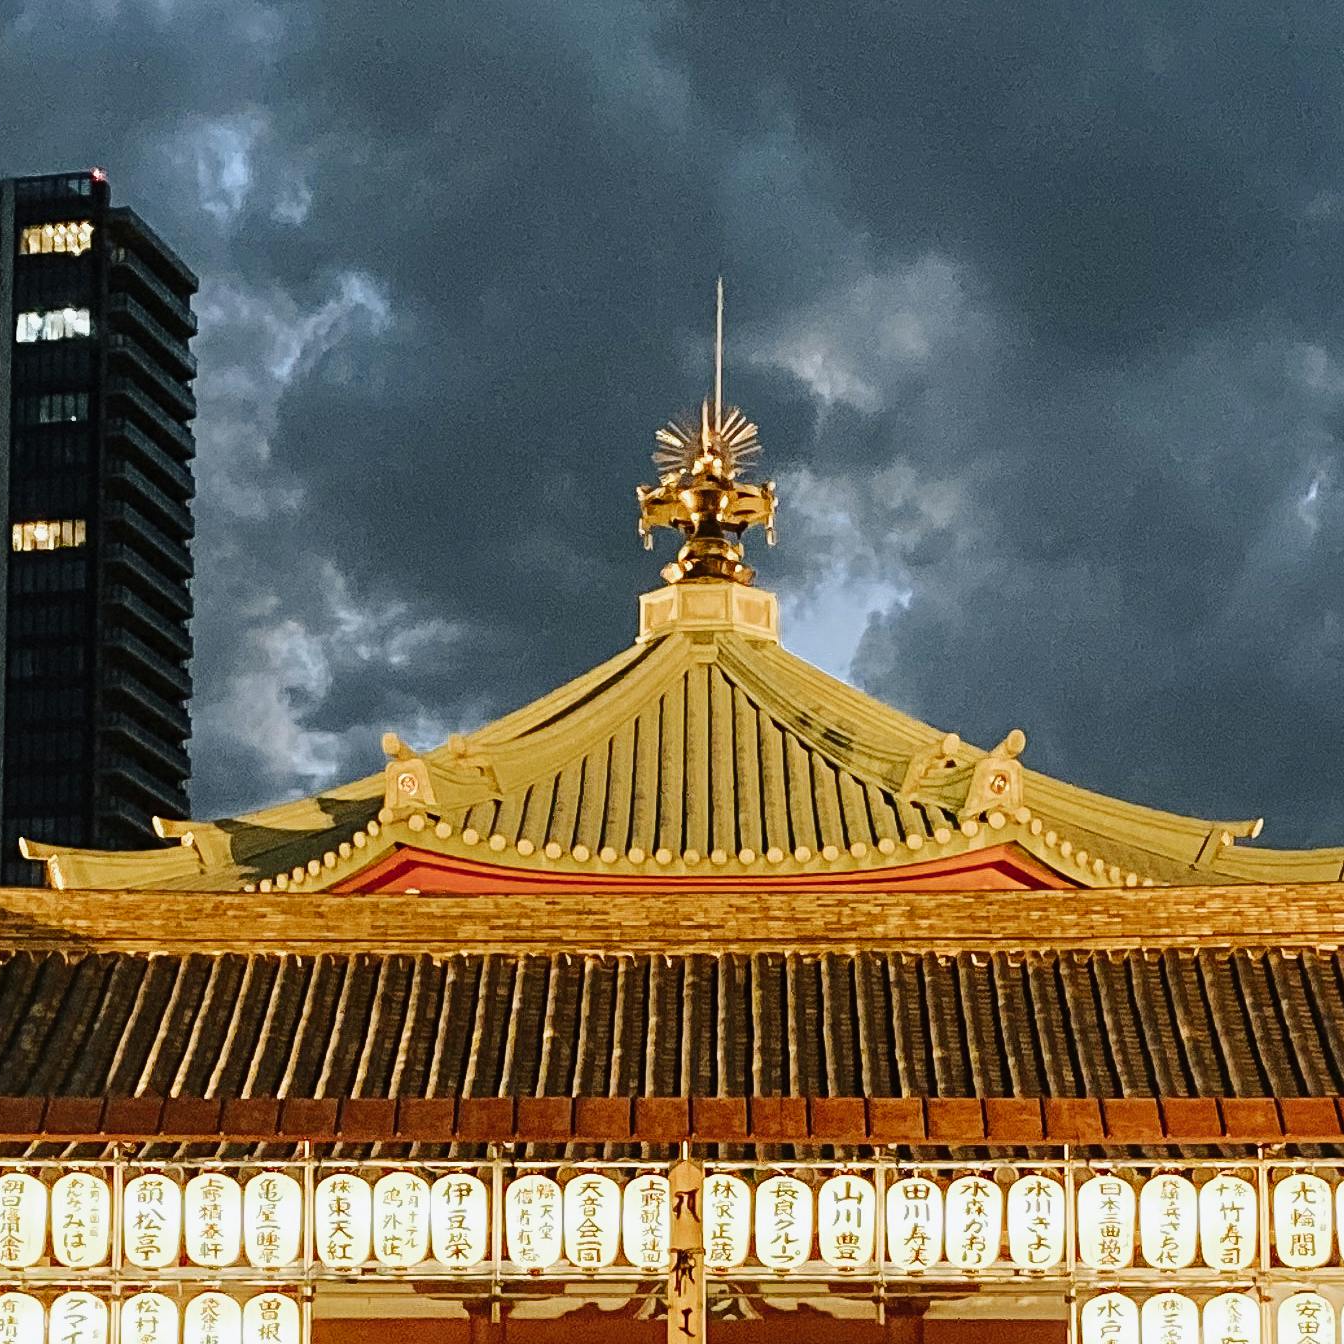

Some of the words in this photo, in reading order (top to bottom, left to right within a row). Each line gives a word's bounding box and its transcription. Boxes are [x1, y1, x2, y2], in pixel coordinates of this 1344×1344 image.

[832, 1181, 864, 1261] 山川豊
[959, 1181, 990, 1264] 水森かおり
